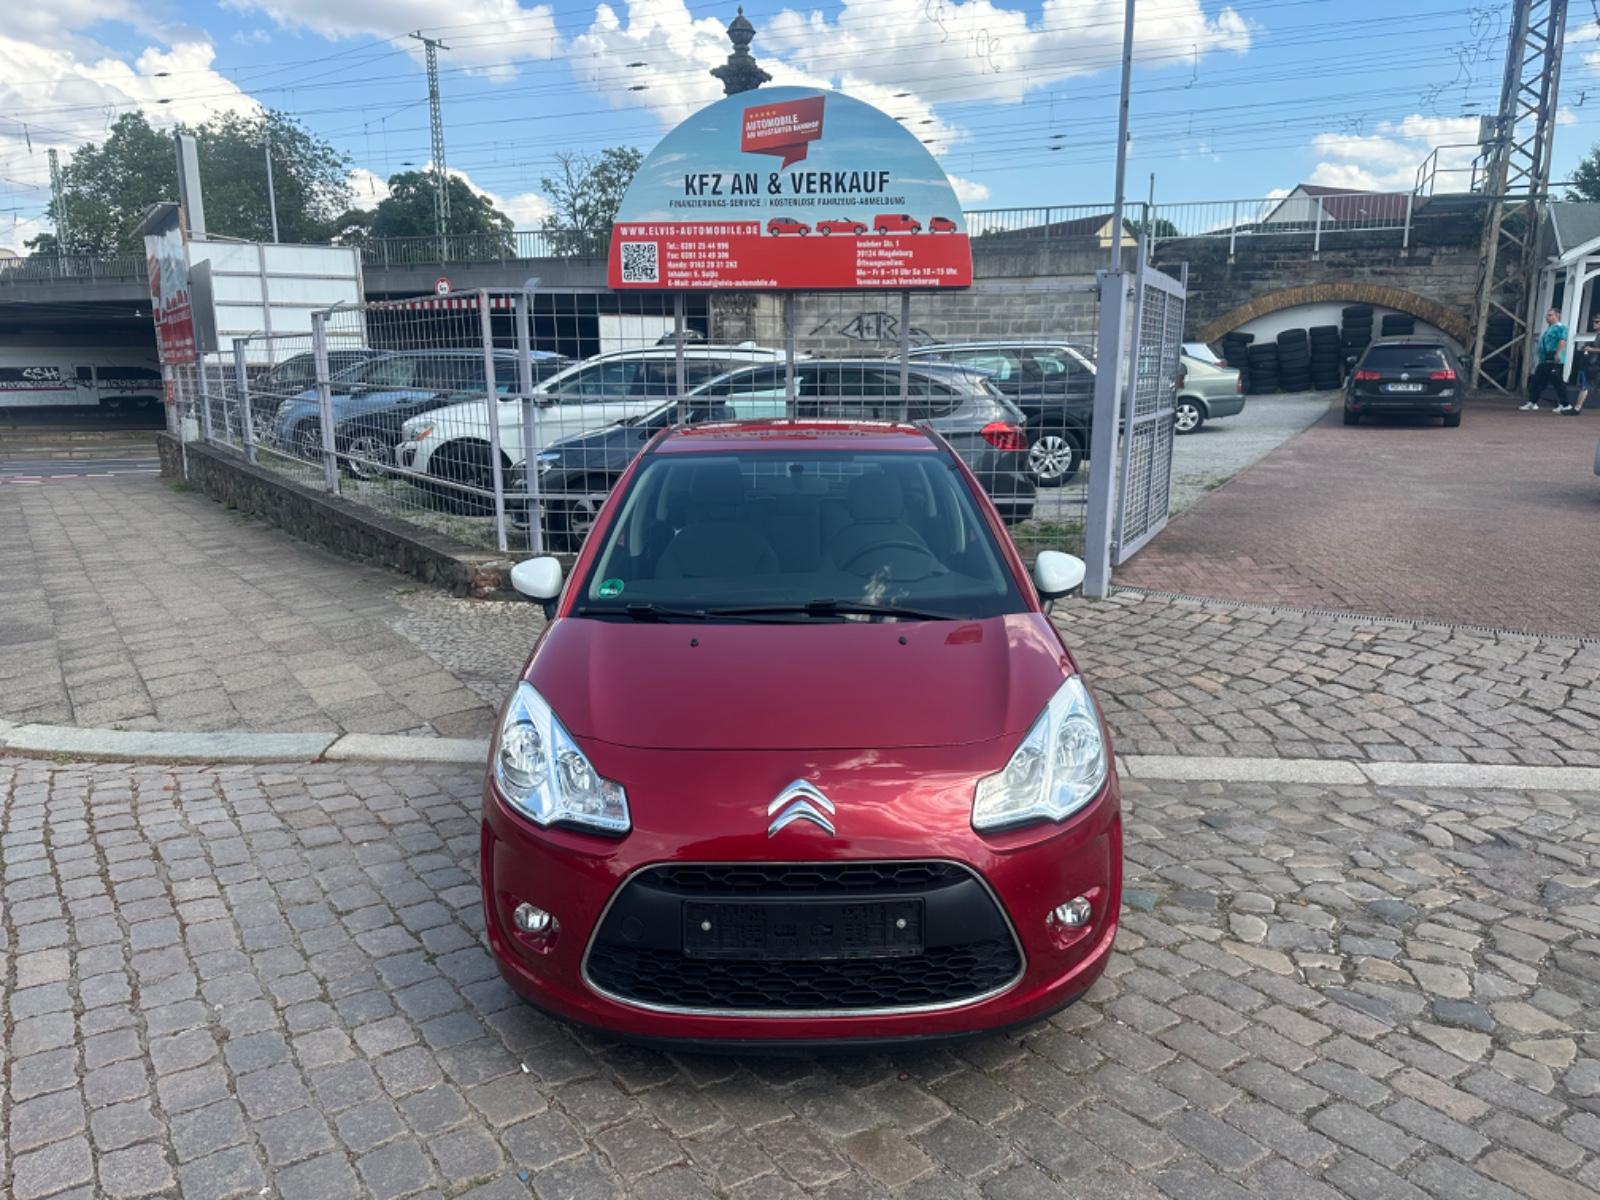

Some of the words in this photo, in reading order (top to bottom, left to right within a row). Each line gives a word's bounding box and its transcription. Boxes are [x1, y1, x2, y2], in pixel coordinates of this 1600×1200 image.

[746, 114, 800, 131] AUTOMOBILE
[684, 173, 723, 196] KFZ
[731, 172, 758, 195] AN
[768, 172, 782, 195] &
[791, 171, 890, 194] VERKAUF
[669, 198, 761, 208] FINANZIERUNGS-SERVICE
[769, 197, 815, 207] KOSTENLOSE
[817, 196, 905, 206] FAHRZEUG-ABMELDUNG
[620, 225, 759, 236] WWW.ELVIS-AUTOMOBILE.DE
[877, 250, 913, 258] Magdeburg
[856, 278, 880, 286] Termine
[882, 277, 897, 285] nach
[898, 277, 940, 286] Vereinbarung
